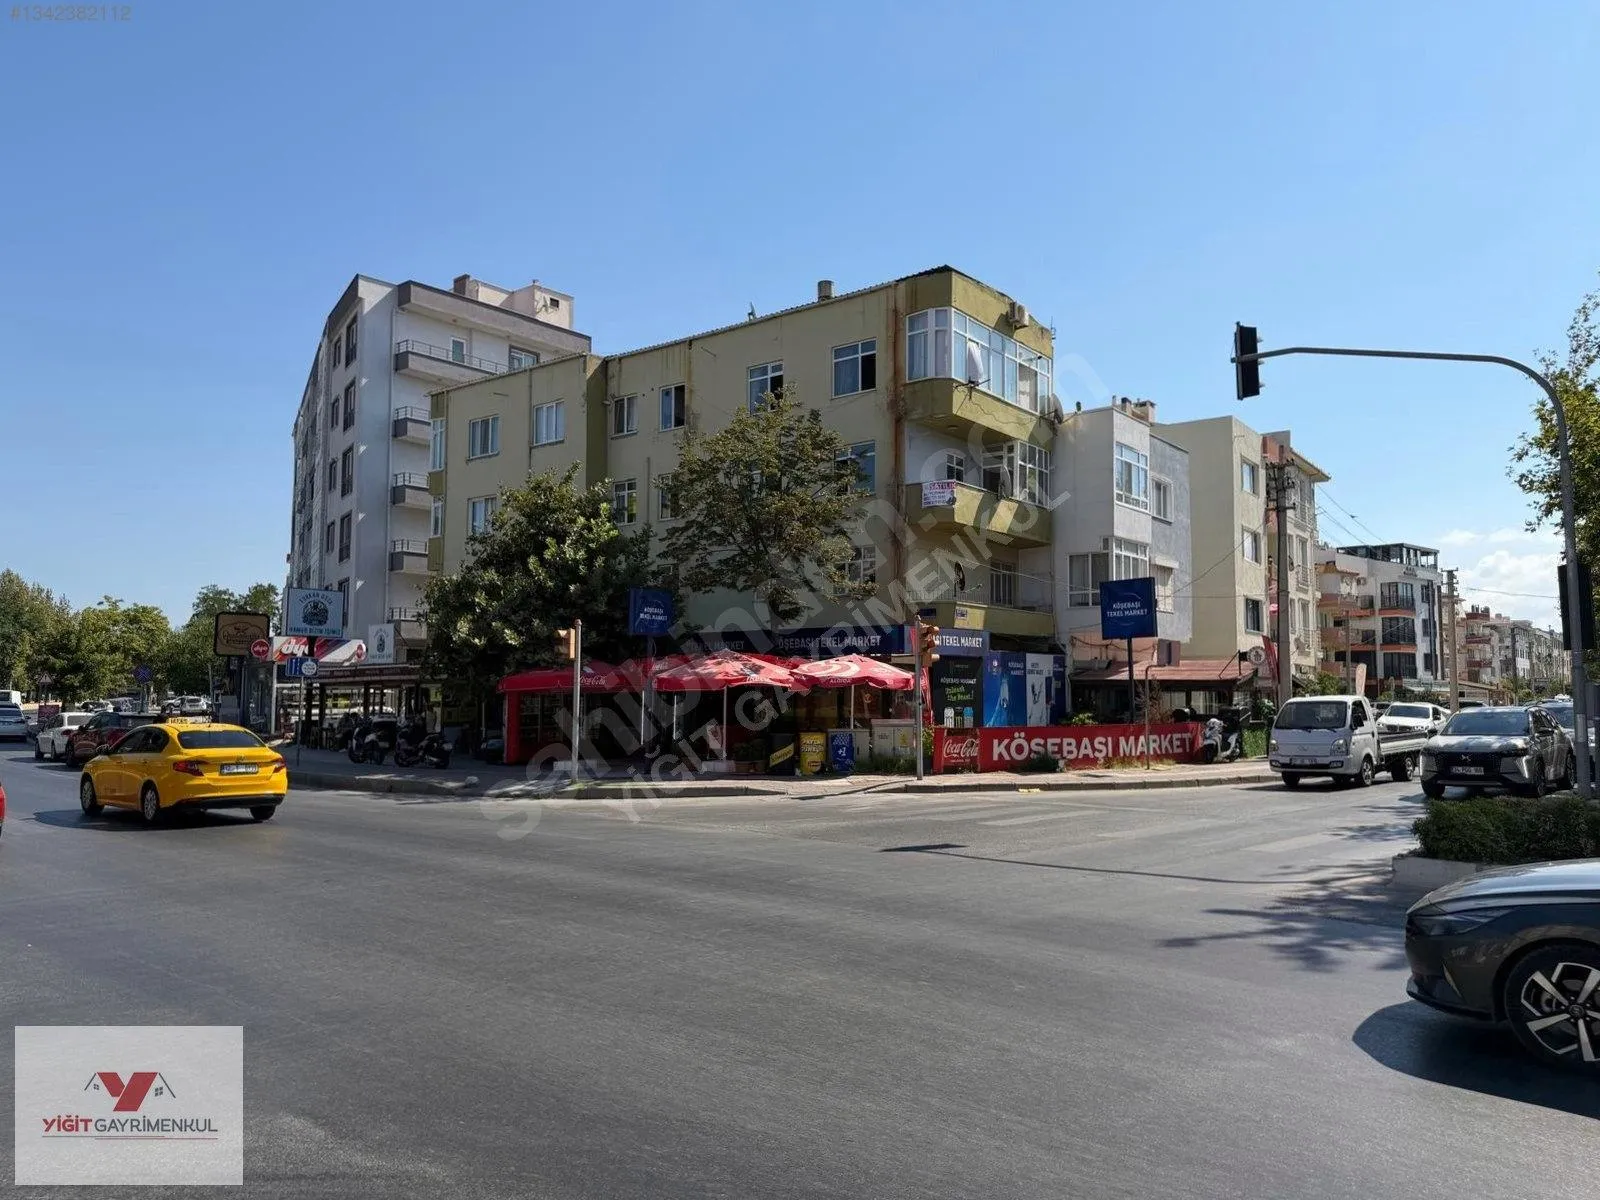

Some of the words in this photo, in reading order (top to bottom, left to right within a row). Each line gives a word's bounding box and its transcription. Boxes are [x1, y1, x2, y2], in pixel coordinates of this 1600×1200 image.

[844, 635, 881, 647] MARKET
[942, 635, 960, 647] TEKEL
[960, 637, 983, 648] MARKET
[1118, 733, 1194, 757] MARKET
